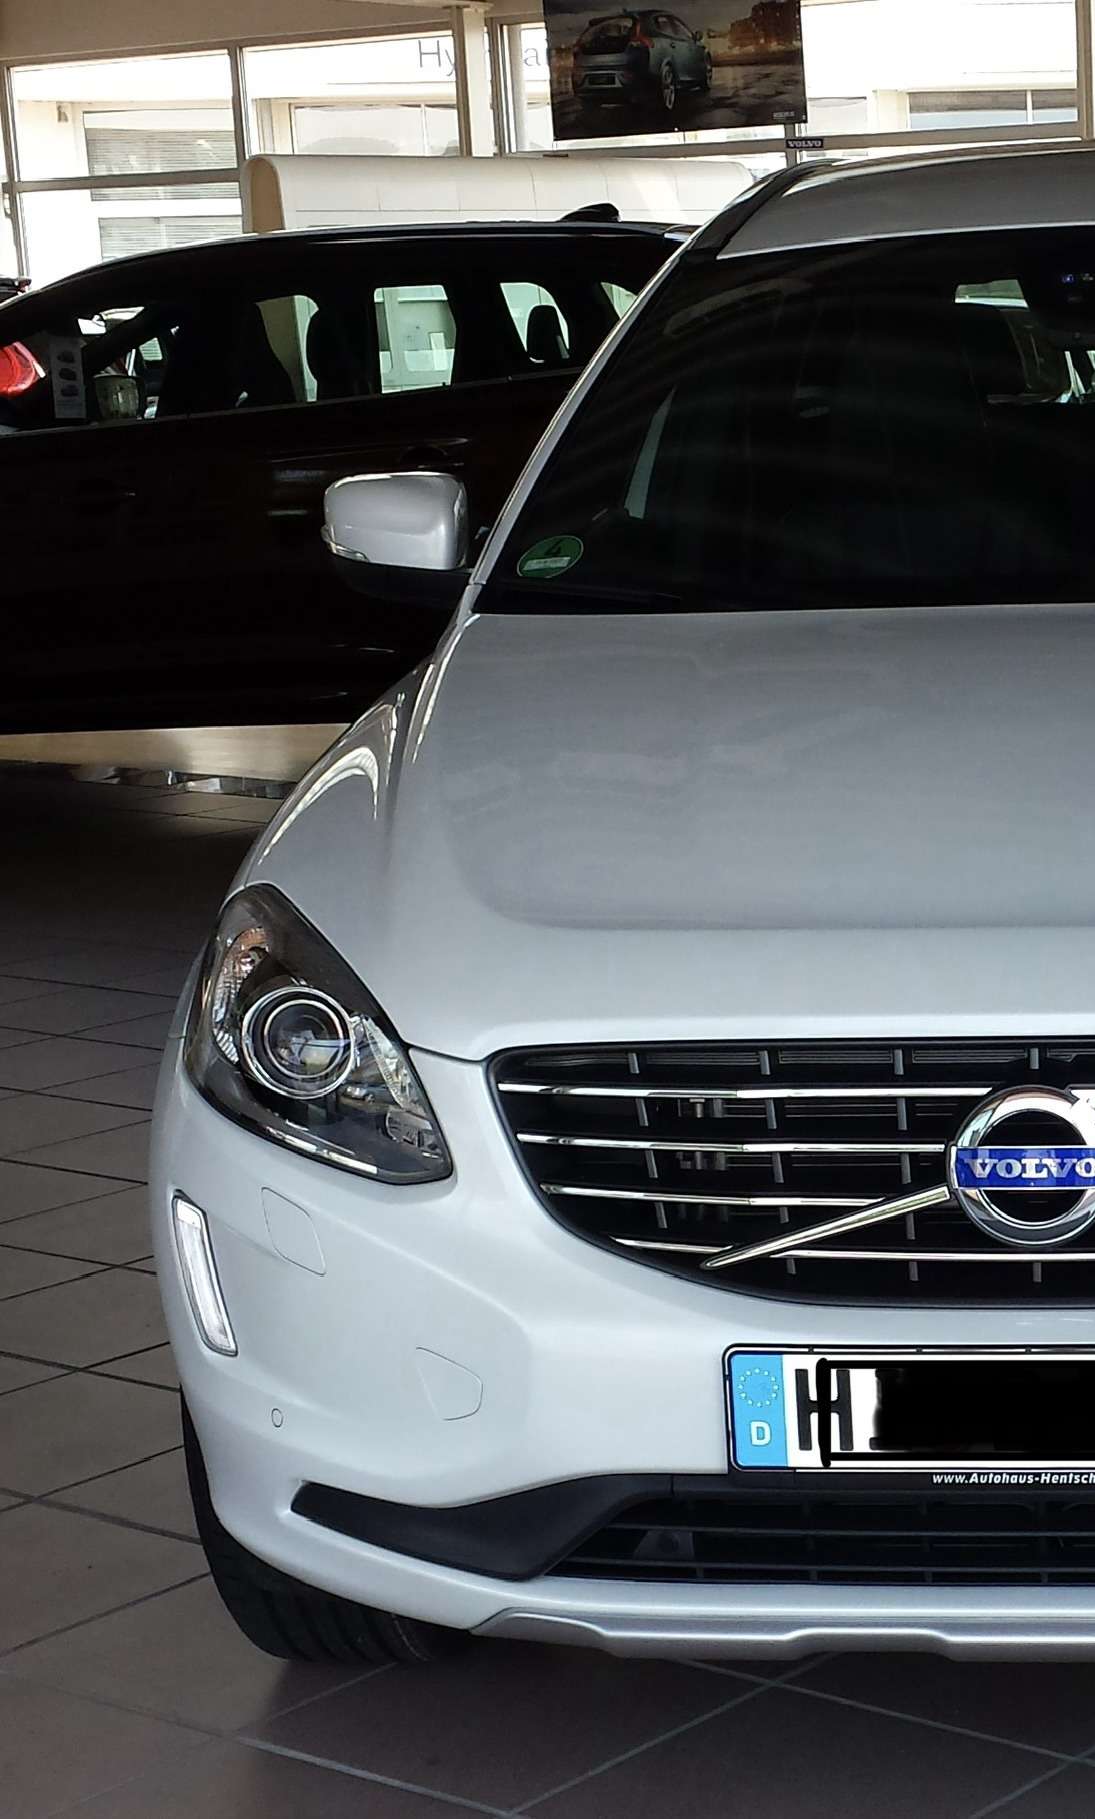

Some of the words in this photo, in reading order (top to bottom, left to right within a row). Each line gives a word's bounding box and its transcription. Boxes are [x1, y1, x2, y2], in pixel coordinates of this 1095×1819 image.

[788, 140, 822, 148] VOLVO
[795, 1368, 854, 1452] H
[750, 1420, 772, 1446] D
